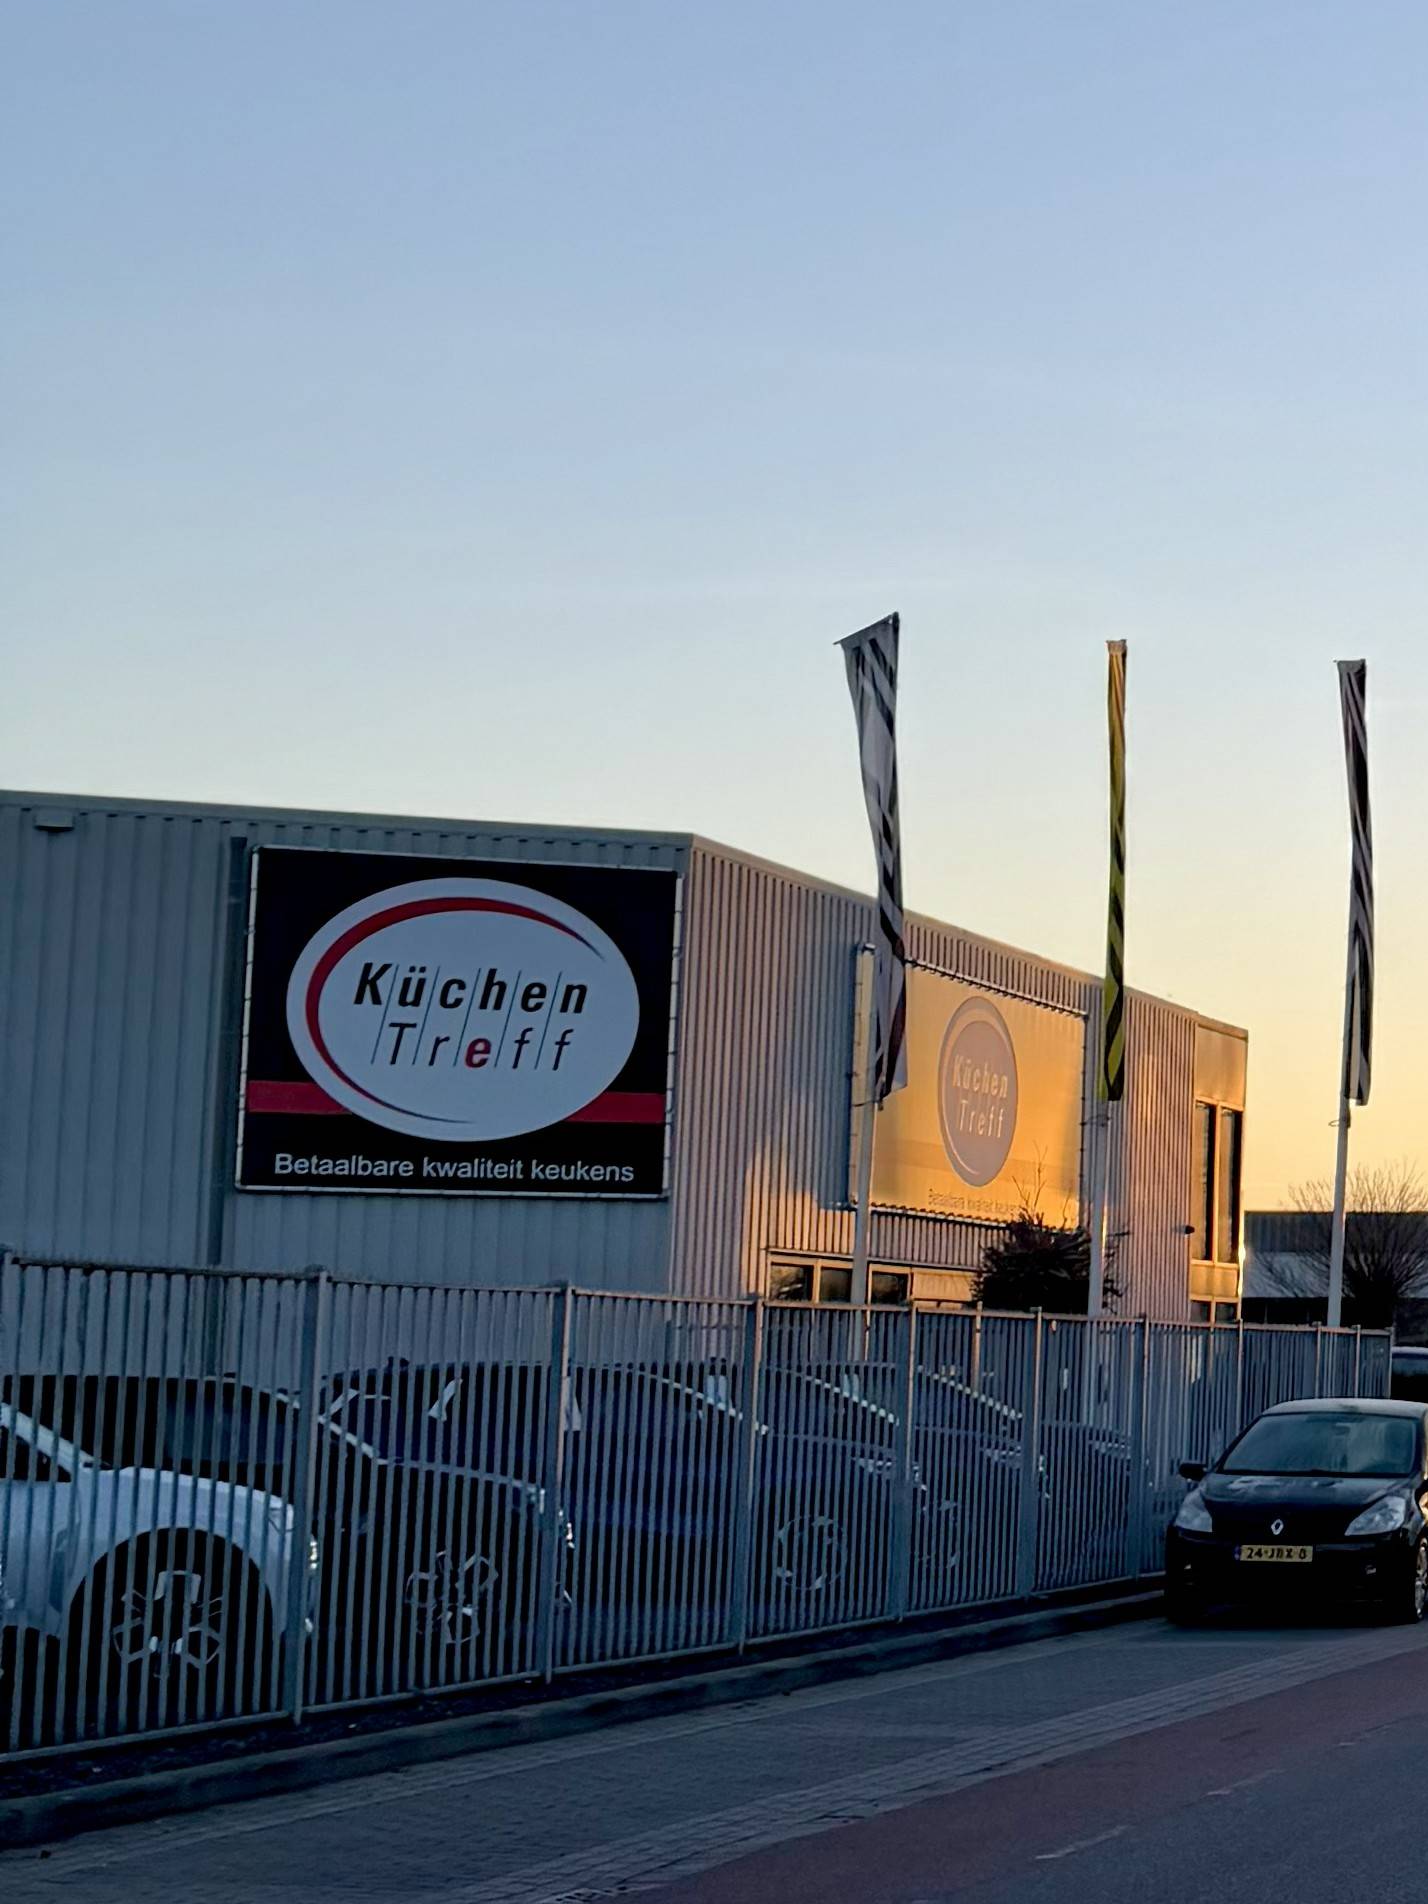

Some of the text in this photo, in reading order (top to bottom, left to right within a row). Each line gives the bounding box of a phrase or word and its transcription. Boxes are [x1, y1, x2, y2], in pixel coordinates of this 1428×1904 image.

[353, 962, 589, 1014] Küchen
[388, 1022, 575, 1071] Treff
[952, 1054, 1009, 1098] Küchen
[959, 1099, 1005, 1139] Treff
[274, 1152, 635, 1182] Betaalbare kwaliteit keukens
